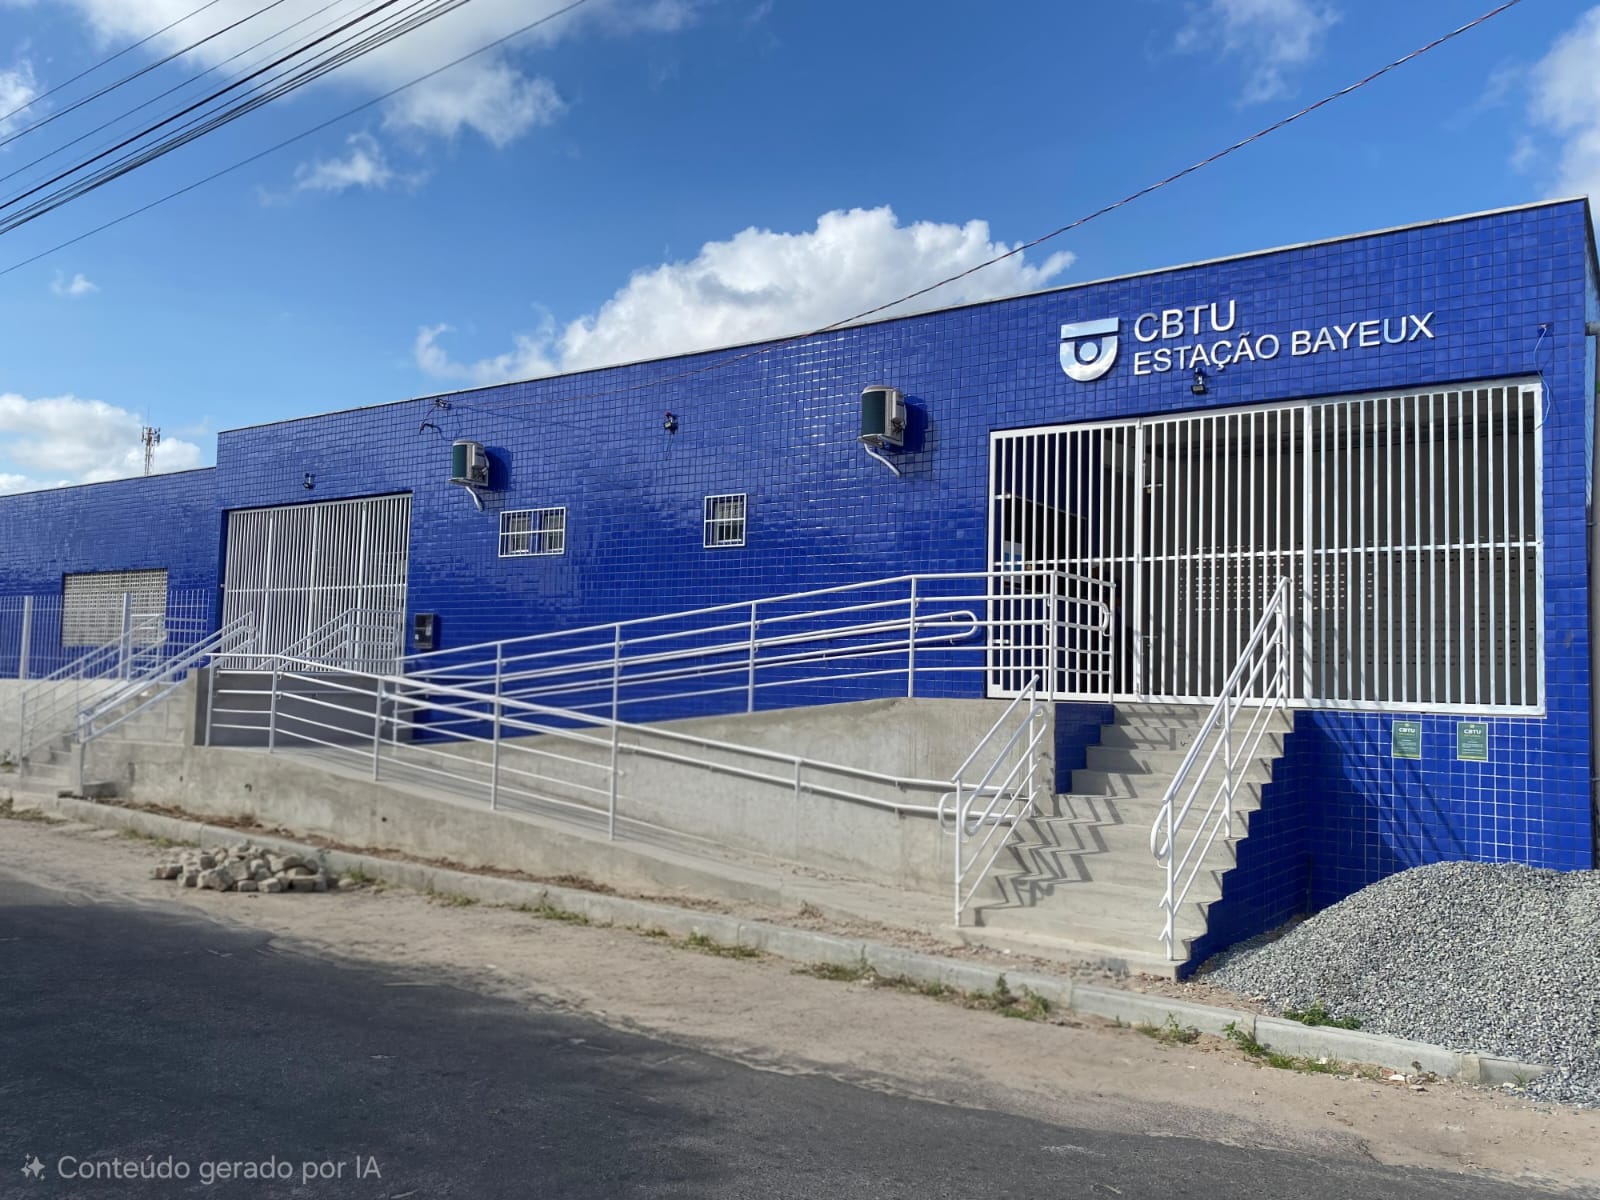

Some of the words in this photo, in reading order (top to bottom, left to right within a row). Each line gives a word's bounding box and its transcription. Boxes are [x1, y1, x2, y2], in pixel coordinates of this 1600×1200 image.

[1133, 299, 1236, 343] CBTU
[1133, 331, 1280, 376] ESTAÇÃO
[1291, 311, 1435, 357] BAYEUX
